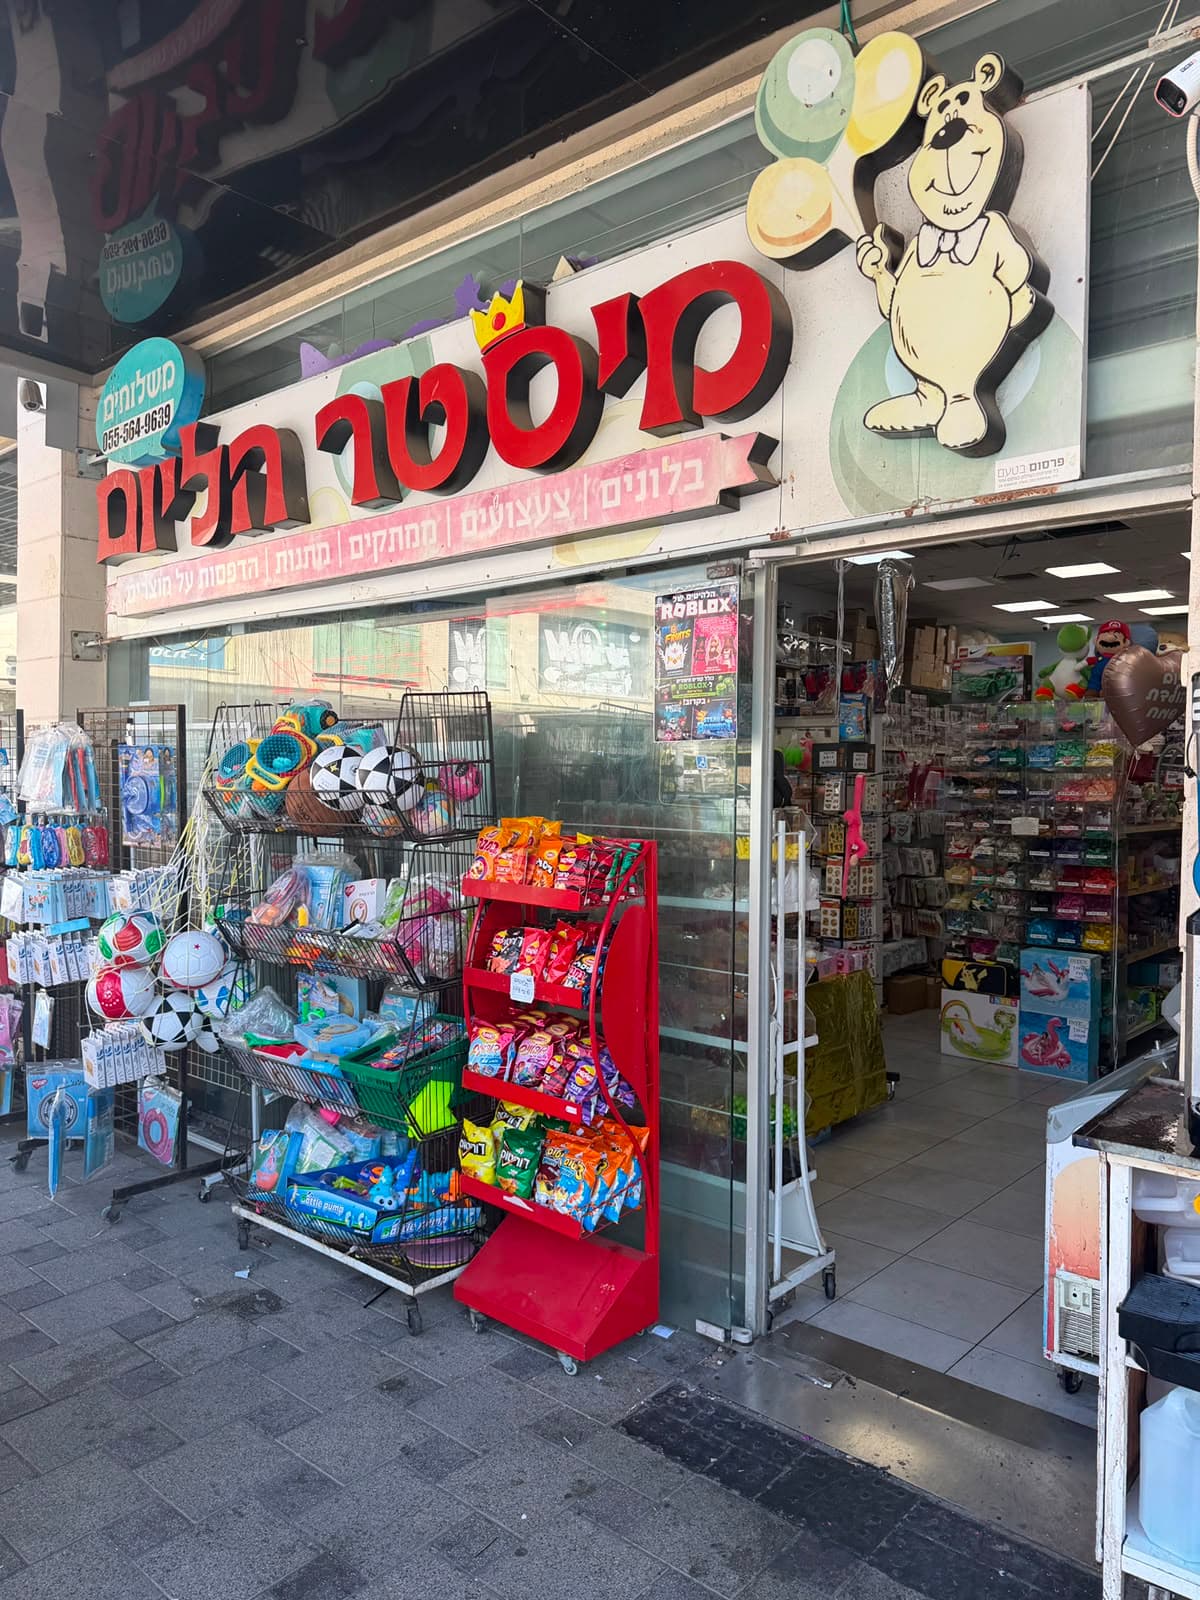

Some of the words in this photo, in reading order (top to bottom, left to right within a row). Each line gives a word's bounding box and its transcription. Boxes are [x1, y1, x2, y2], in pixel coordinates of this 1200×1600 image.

[103, 360, 176, 423] משלוחים
[315, 260, 772, 506] מיסטר
[102, 403, 172, 452] 055-564-9639
[602, 456, 705, 510] בלונים
[997, 464, 1026, 478] בטעם
[1029, 457, 1065, 473] פרסום
[96, 422, 288, 563] הליום
[460, 488, 573, 538] צעצועים
[275, 541, 331, 574] מתנות
[349, 518, 437, 562] ממתקים
[175, 571, 194, 593] על
[199, 556, 260, 587] הדפסות
[660, 596, 732, 620] ROBLOX
